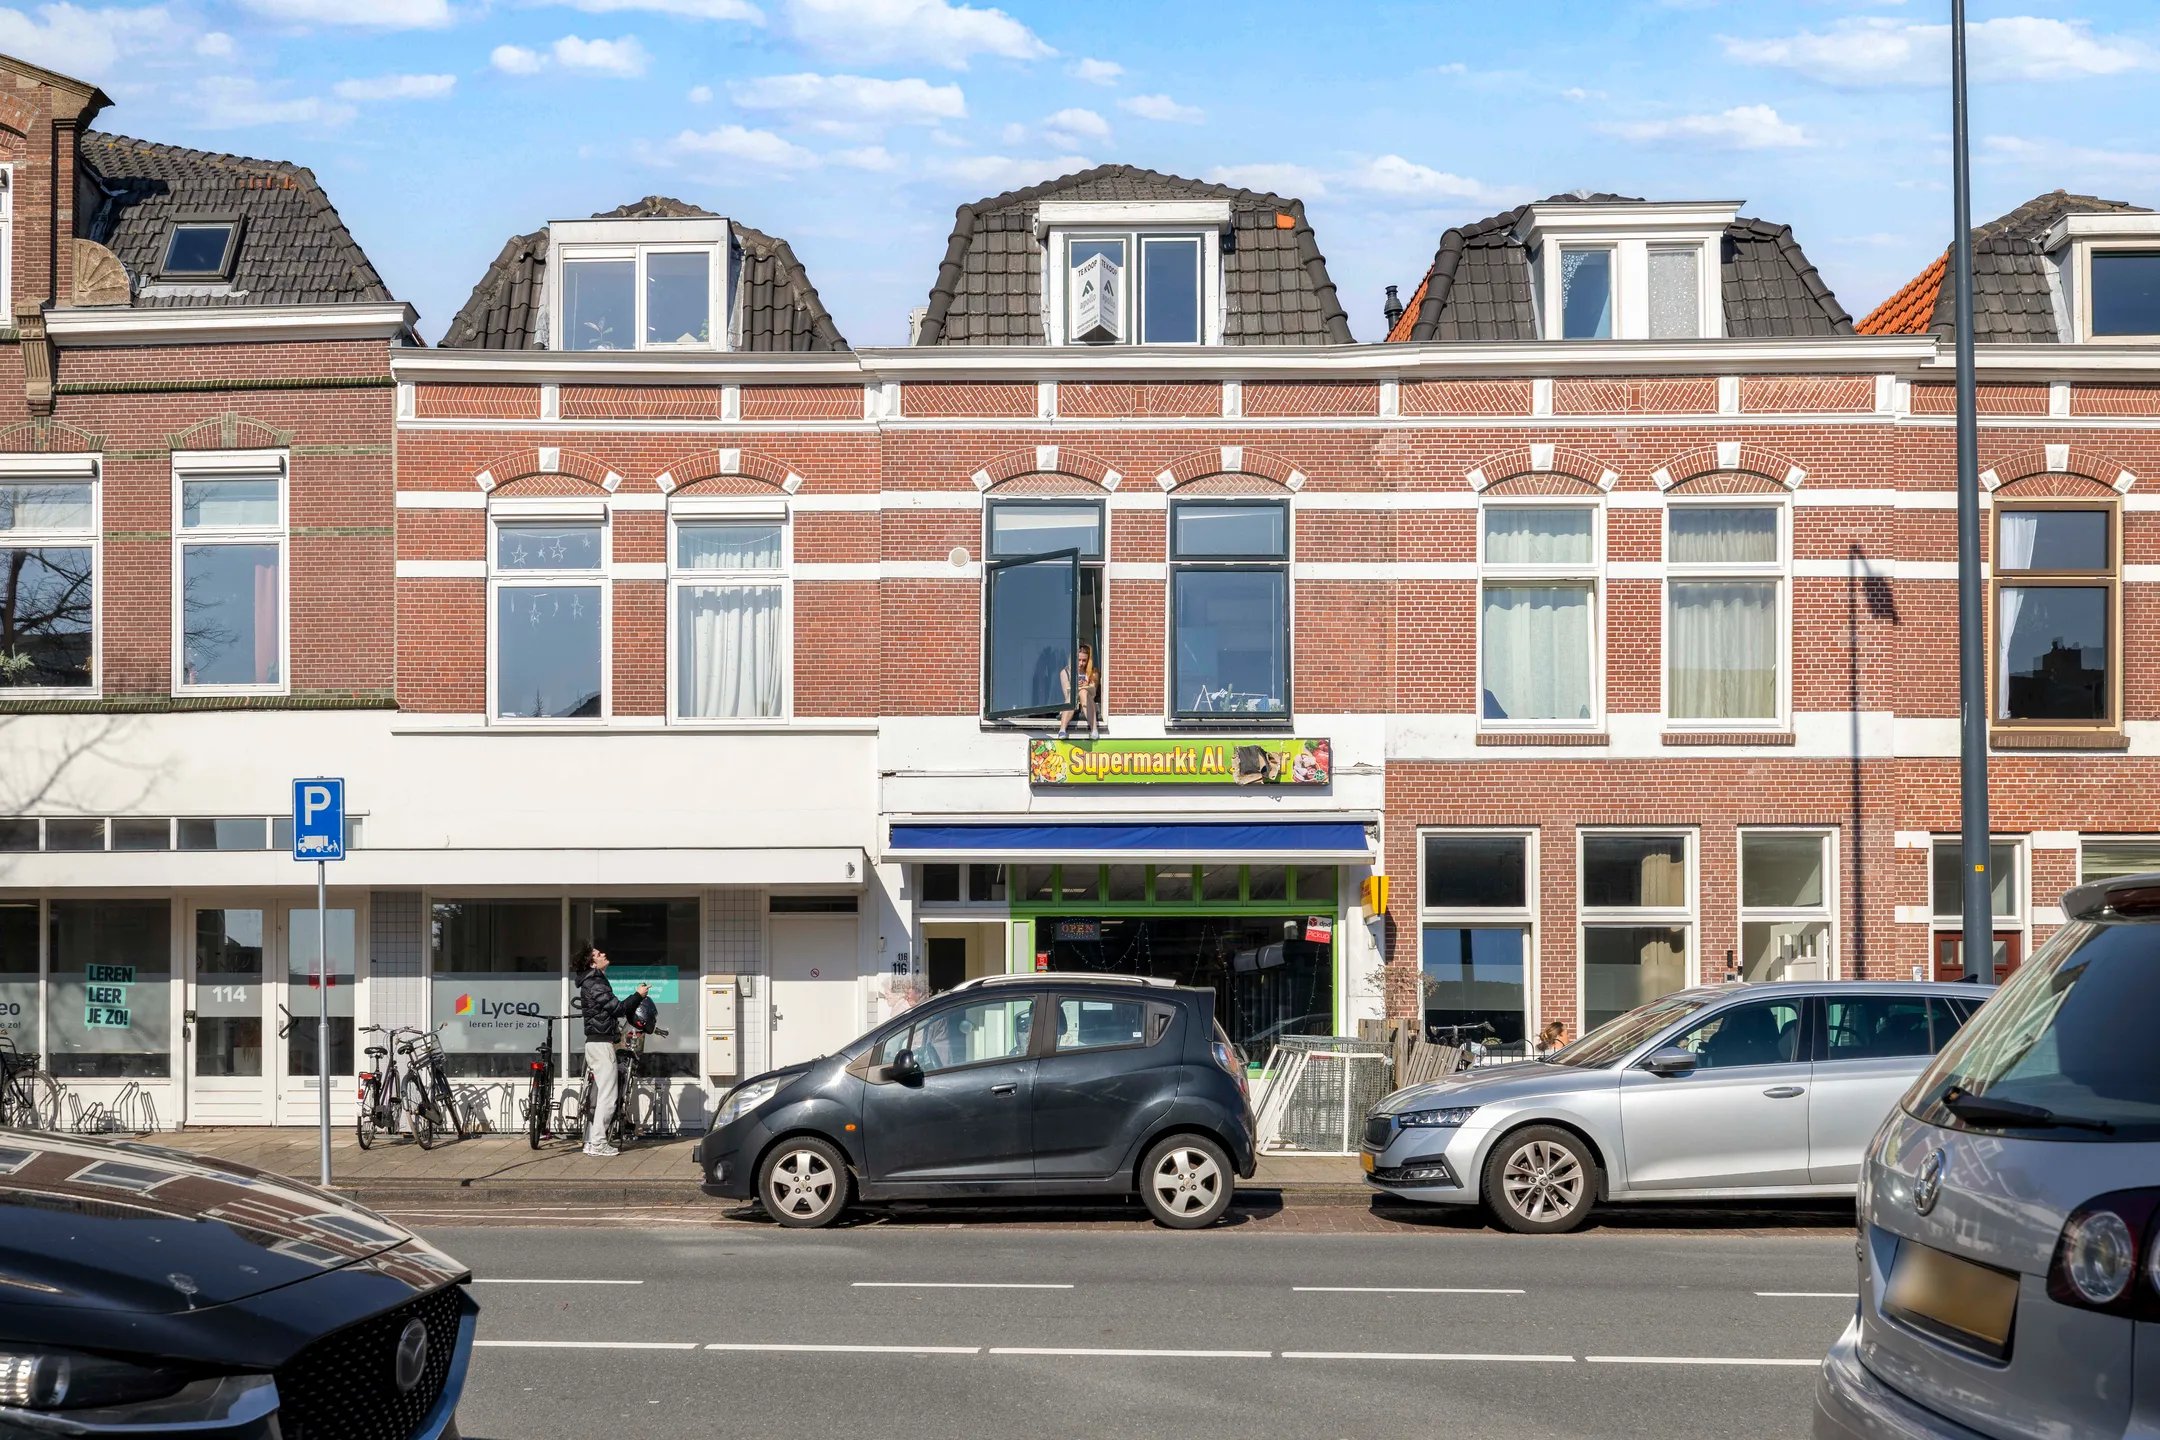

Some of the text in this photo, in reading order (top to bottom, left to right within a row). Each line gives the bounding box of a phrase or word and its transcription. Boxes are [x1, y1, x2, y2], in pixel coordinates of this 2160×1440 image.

[1069, 746, 1198, 781] Supermarkt
[1200, 746, 1226, 775] Al
[304, 786, 332, 825] P
[1061, 924, 1094, 933] OPEN
[1319, 920, 1332, 928] dpd
[88, 965, 133, 983] LEREN
[892, 962, 908, 976] 116
[88, 987, 122, 1004] LEER
[212, 986, 247, 1002] 114
[87, 1008, 129, 1026] JE ZO!
[482, 998, 540, 1019] Lyceo
[469, 1020, 493, 1028] leren
[495, 1020, 513, 1028] leer
[515, 1020, 524, 1029] je
